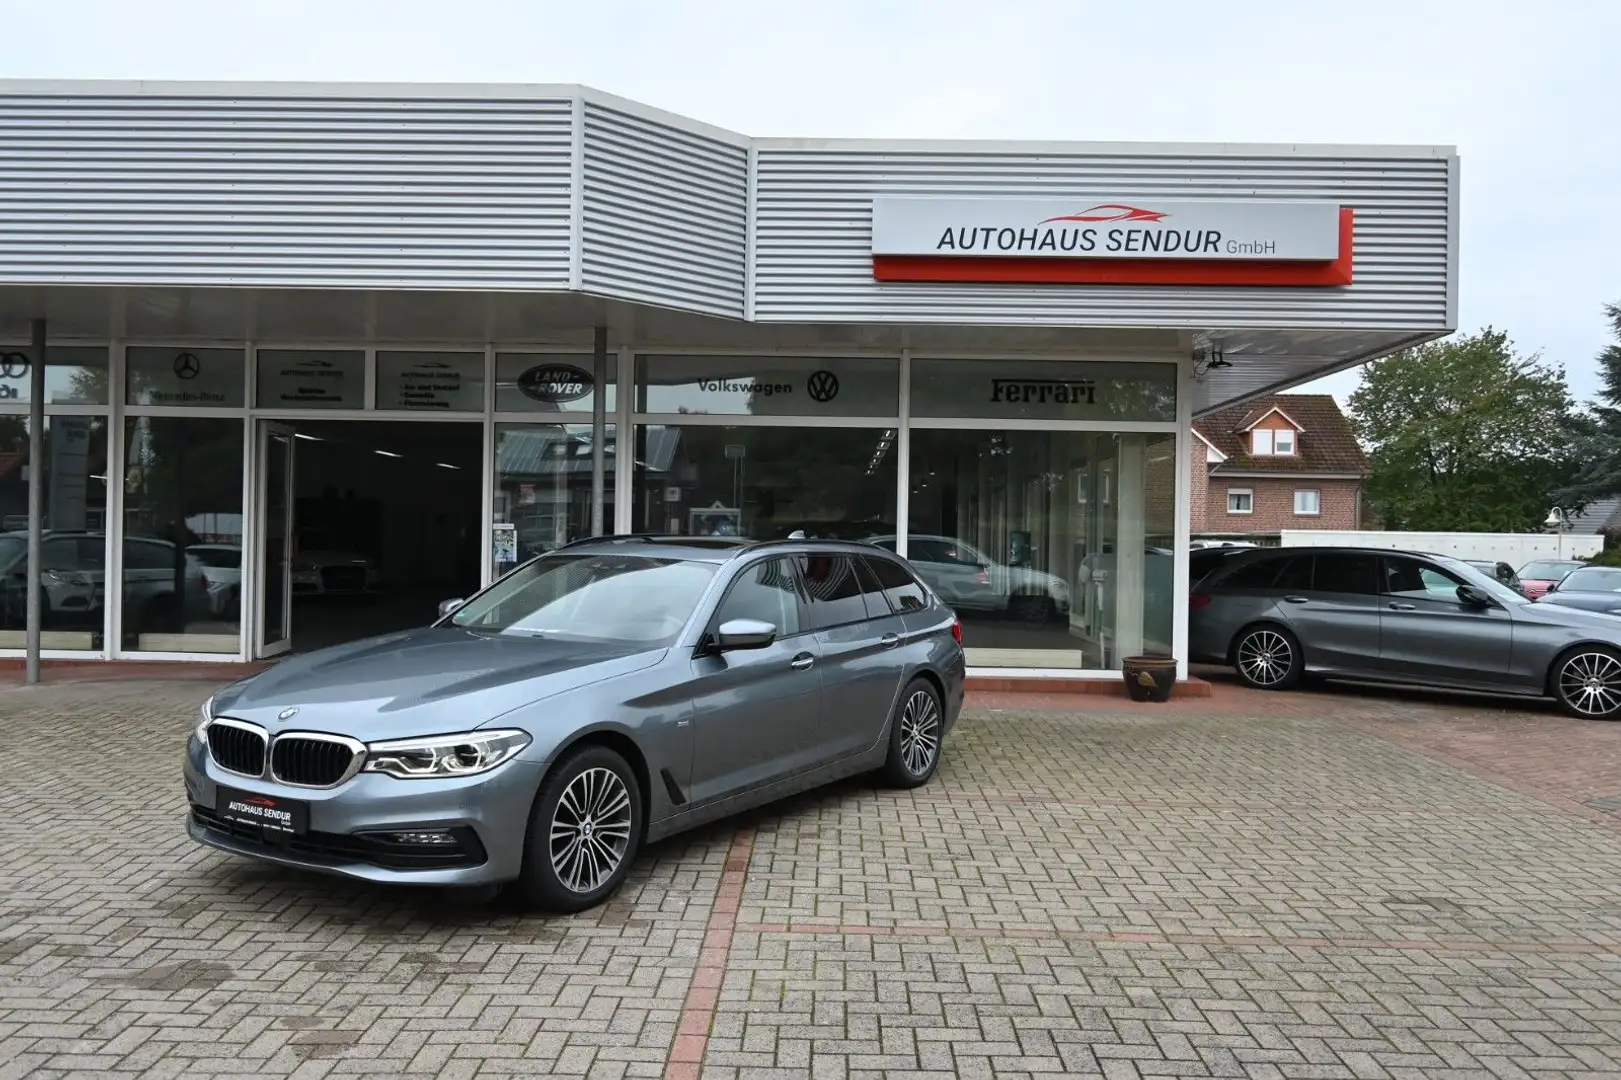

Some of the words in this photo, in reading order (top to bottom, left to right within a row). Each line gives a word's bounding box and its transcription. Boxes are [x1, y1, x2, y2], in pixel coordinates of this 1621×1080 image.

[936, 227, 1097, 251] AUTOHAUS
[1105, 229, 1221, 253] SENDUR
[1226, 240, 1276, 255] GmbH
[697, 378, 792, 396] Volkswagen
[990, 379, 1096, 403] Ferrari
[228, 801, 263, 816] AUTOHAUS
[263, 808, 291, 821] SENDUR
